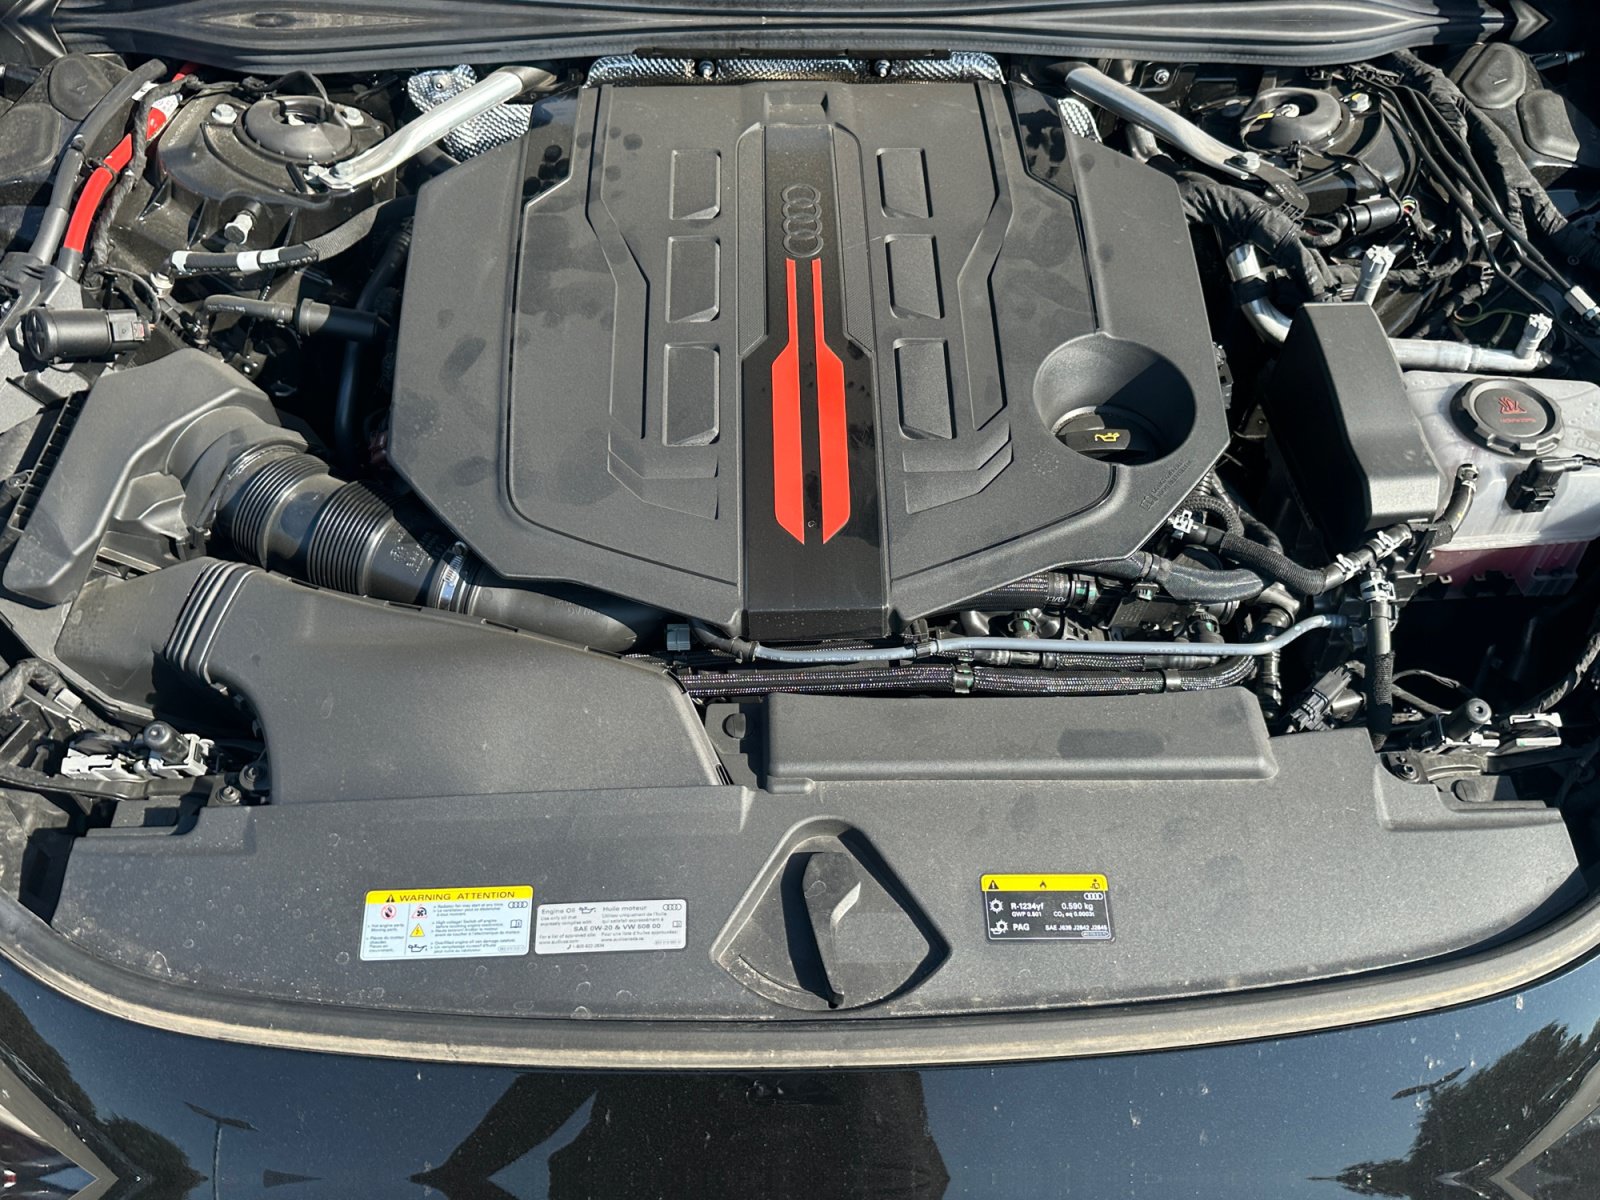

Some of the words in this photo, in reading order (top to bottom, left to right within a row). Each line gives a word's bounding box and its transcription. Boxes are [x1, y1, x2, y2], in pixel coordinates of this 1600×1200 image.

[399, 893, 451, 902] WARNING
[457, 891, 516, 900] ATTENTION
[1010, 903, 1044, 911] R-1234yf
[1084, 903, 1094, 911] kg
